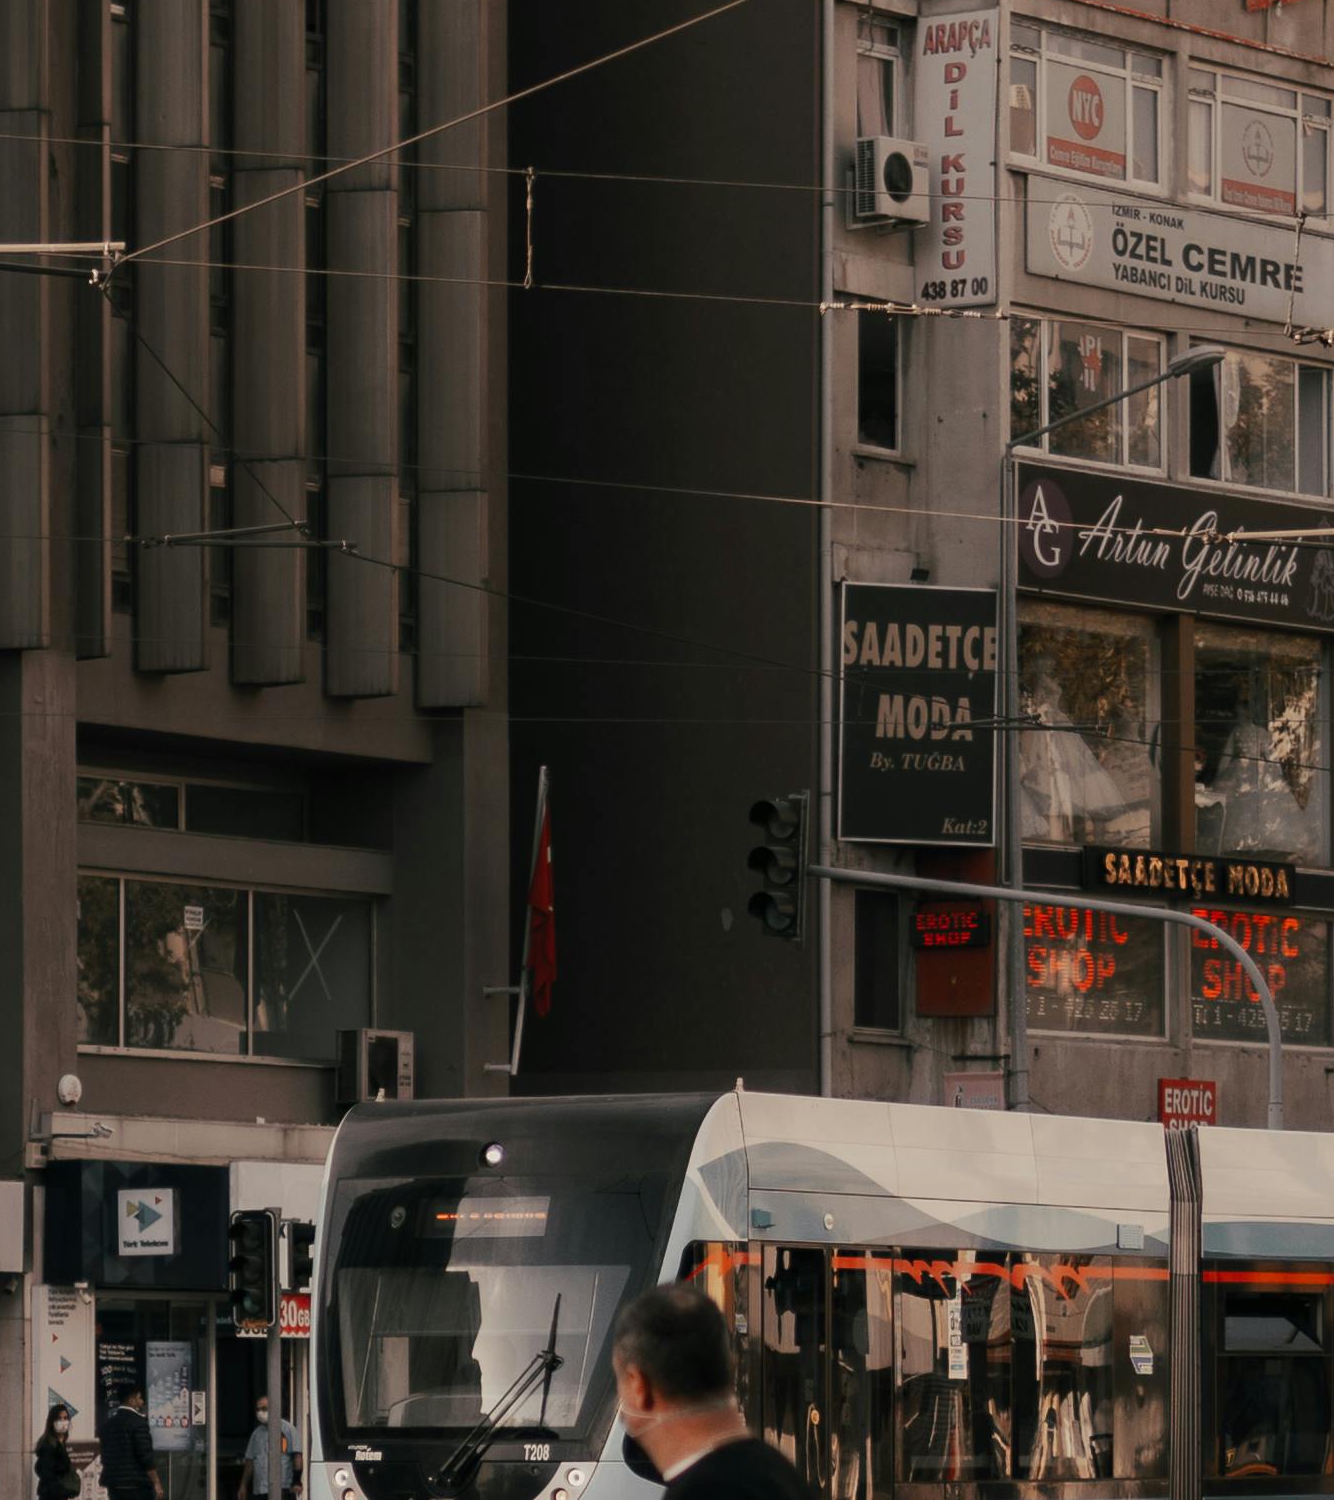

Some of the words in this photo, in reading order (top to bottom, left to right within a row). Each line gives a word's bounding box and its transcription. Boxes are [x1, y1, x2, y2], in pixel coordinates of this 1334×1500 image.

[923, 18, 991, 57] ARAPÇA
[1072, 90, 1100, 127] NYC
[941, 153, 966, 270] KURSU
[1149, 212, 1185, 231] KONAK
[1111, 221, 1173, 268] ÖZEL
[1182, 243, 1305, 294] CEMRE
[921, 281, 947, 301] 438
[950, 279, 967, 298] 87
[972, 277, 988, 296] 00
[1111, 262, 1171, 292] YABANCI
[1200, 282, 1246, 306] KURSU
[1078, 495, 1171, 570] Artun
[1176, 509, 1300, 601] Gelinlik
[843, 619, 997, 680] SAADETÇE
[875, 693, 974, 742] MODA
[900, 750, 967, 772] TUĞBA
[1104, 851, 1216, 899] SAADETÇE
[1226, 864, 1291, 900] MODA
[1027, 945, 1117, 993] SHOP
[524, 1444, 550, 1461] T208
